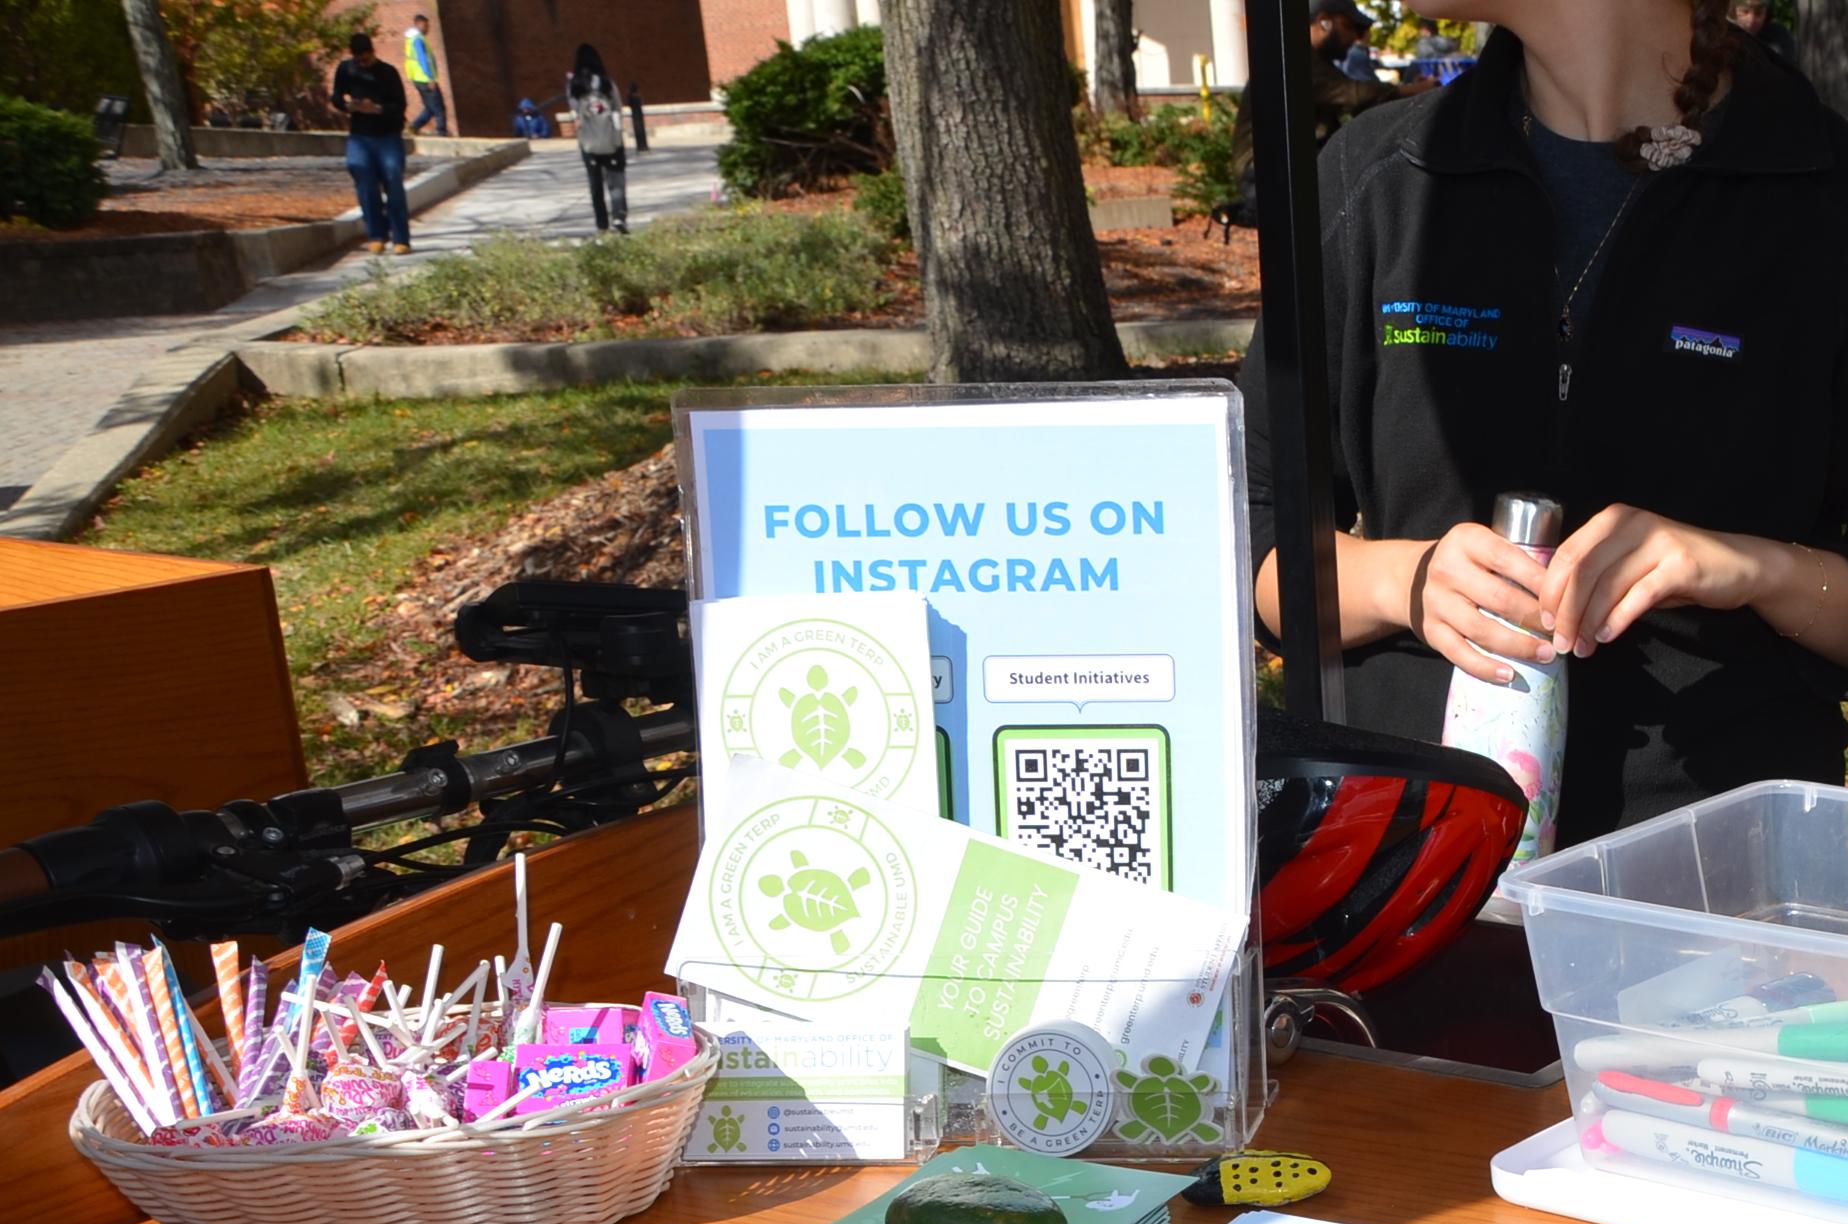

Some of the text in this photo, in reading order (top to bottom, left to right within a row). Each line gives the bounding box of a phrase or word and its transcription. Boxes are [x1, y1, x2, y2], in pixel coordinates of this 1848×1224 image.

[1416, 314, 1469, 328] OFFICE OF
[1424, 303, 1440, 313] OF
[1441, 304, 1500, 319] MARYLAND
[1394, 326, 1498, 350] sustainability
[1674, 338, 1734, 358] patagonia
[764, 500, 1165, 540] FOLLOW US ON
[814, 557, 1119, 594] INSTAGRAM
[757, 642, 779, 663] AM
[782, 636, 792, 648] A
[794, 629, 846, 645] GREEN
[850, 637, 884, 667] TERP
[1009, 669, 1150, 687] Student Initiatives
[745, 813, 780, 843] TERP
[721, 842, 748, 894] GREEN
[721, 898, 732, 908] A
[847, 851, 908, 984] SUSTAINABLE UMD
[722, 914, 742, 936] AM
[938, 885, 993, 1010] YOUR GUIDE
[963, 893, 1019, 1016] TO CAMPUS
[983, 883, 1049, 1041] SUSTAINABILITY
[719, 1036, 753, 1046] ERSITY
[774, 1034, 833, 1044] MARYLAND
[837, 1034, 876, 1043] OFFICE
[879, 1034, 893, 1042] OF
[1001, 1038, 1054, 1072] COMMIT
[1064, 1041, 1081, 1056] TO
[718, 1046, 893, 1072] stainability
[1009, 1090, 1104, 1147] BE A GREEN TERP
[1765, 1128, 1794, 1142] BIC
